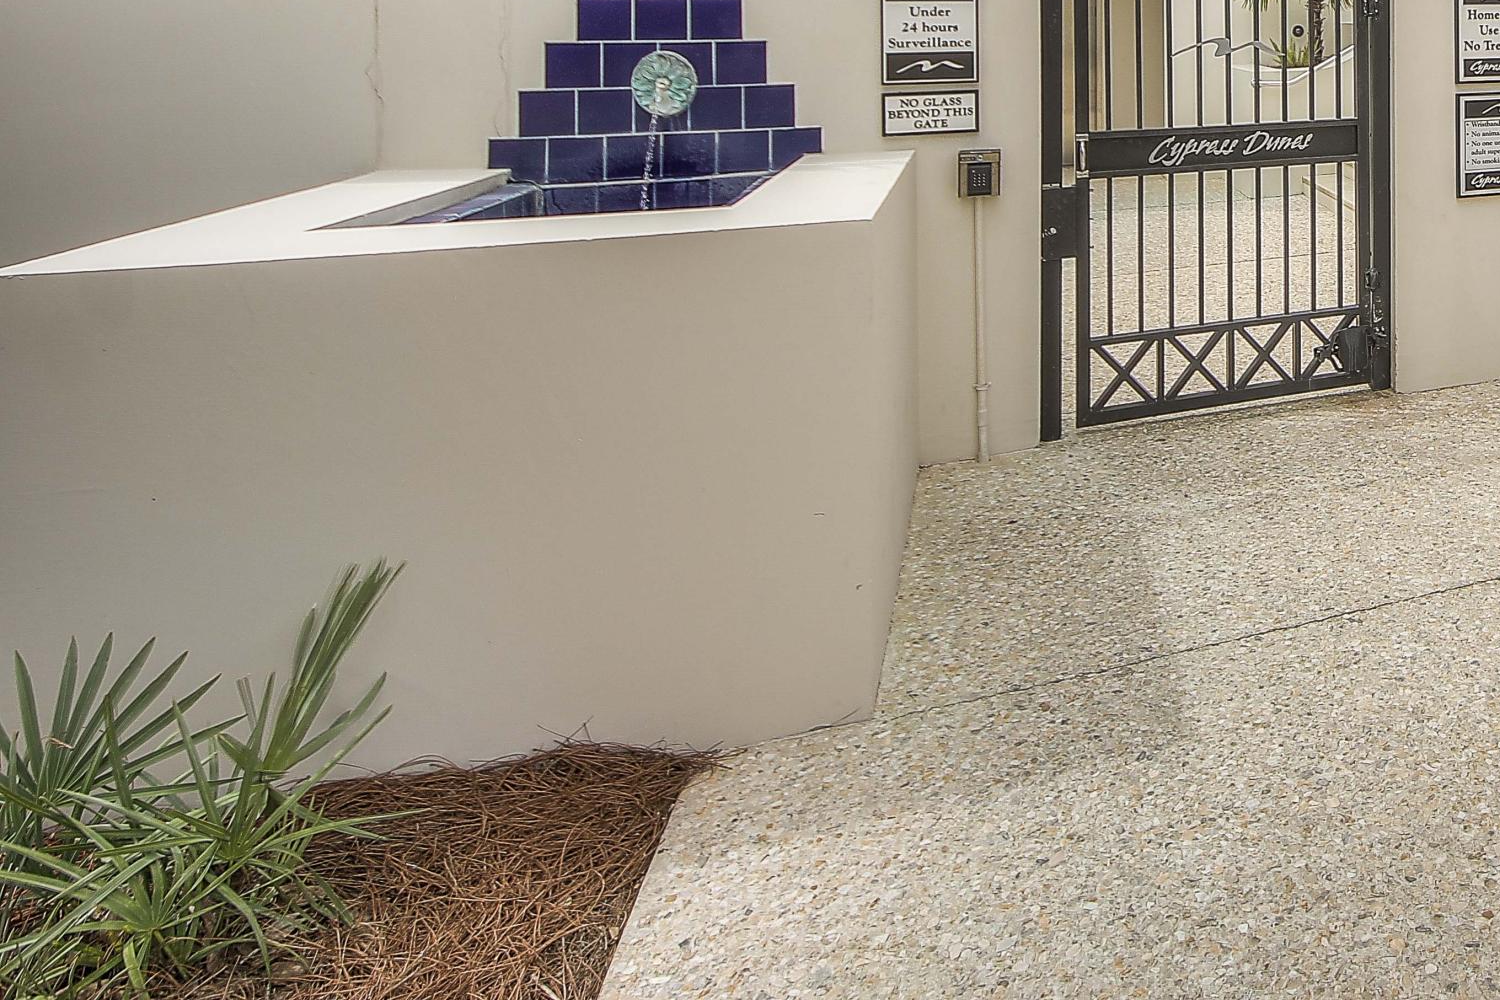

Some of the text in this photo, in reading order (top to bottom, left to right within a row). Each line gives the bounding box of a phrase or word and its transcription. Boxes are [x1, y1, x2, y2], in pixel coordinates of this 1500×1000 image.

[910, 6, 951, 17] Under
[902, 22, 958, 32] 24 hours
[1480, 24, 1499, 36] Use
[888, 37, 972, 48] Surveillance
[1464, 40, 1480, 51] No
[900, 96, 962, 108] NO GLASS
[888, 107, 973, 119] BEYOND THIS
[914, 119, 948, 129] GATE
[1148, 130, 1313, 166] Cypress Dunes
